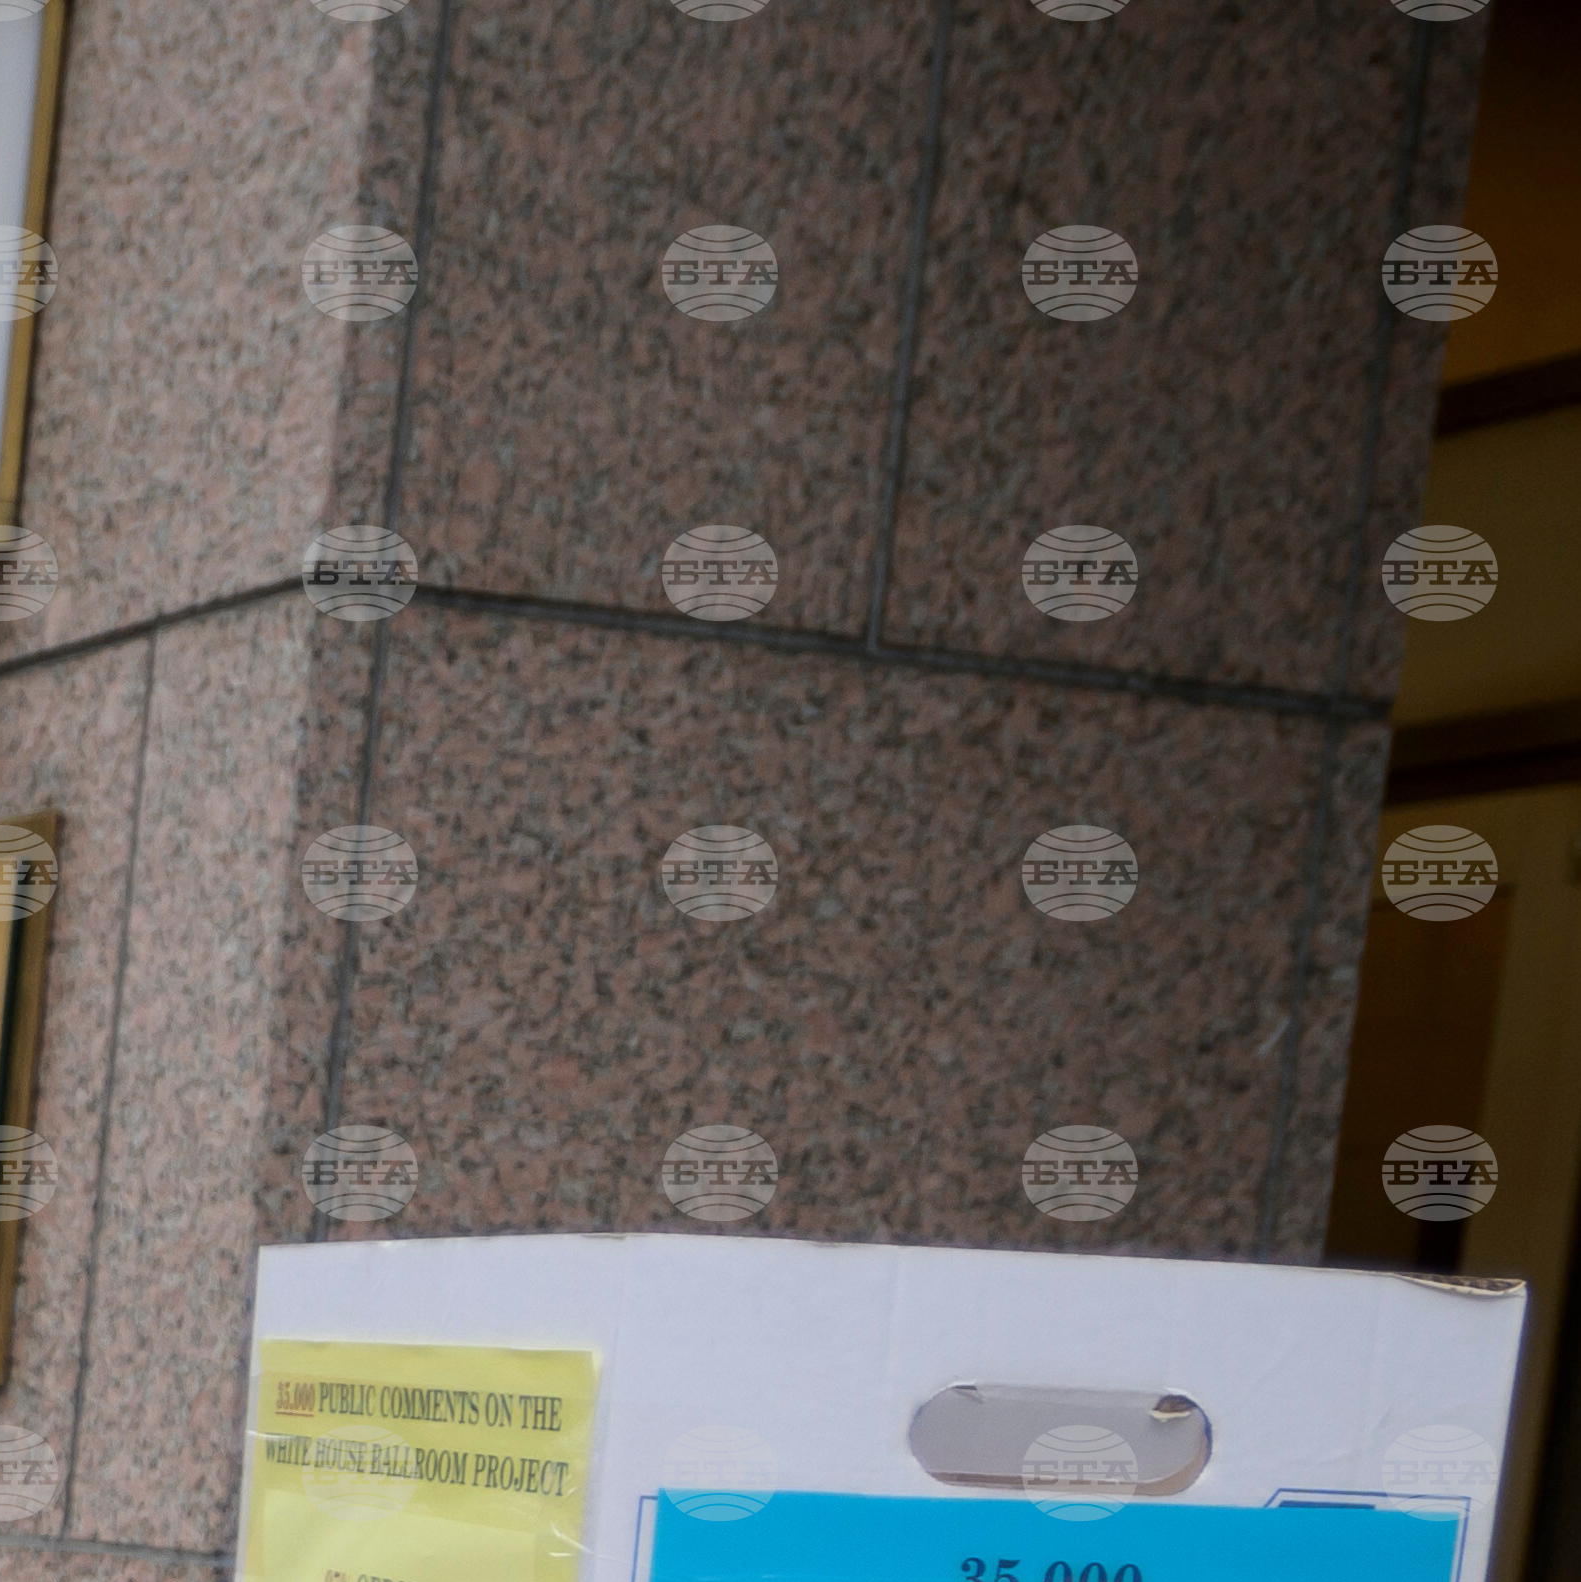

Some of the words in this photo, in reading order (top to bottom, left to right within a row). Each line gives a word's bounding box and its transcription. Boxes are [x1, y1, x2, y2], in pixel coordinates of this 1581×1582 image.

[318, 1382, 376, 1417] PUBLIC
[380, 1386, 480, 1425] COMMENTS
[485, 1392, 514, 1428] ON
[519, 1395, 562, 1432] THE
[265, 1432, 312, 1466] WHITE
[316, 1436, 365, 1474] HOUSE
[370, 1442, 468, 1485] BALLROOM
[472, 1454, 569, 1496] PROJECT
